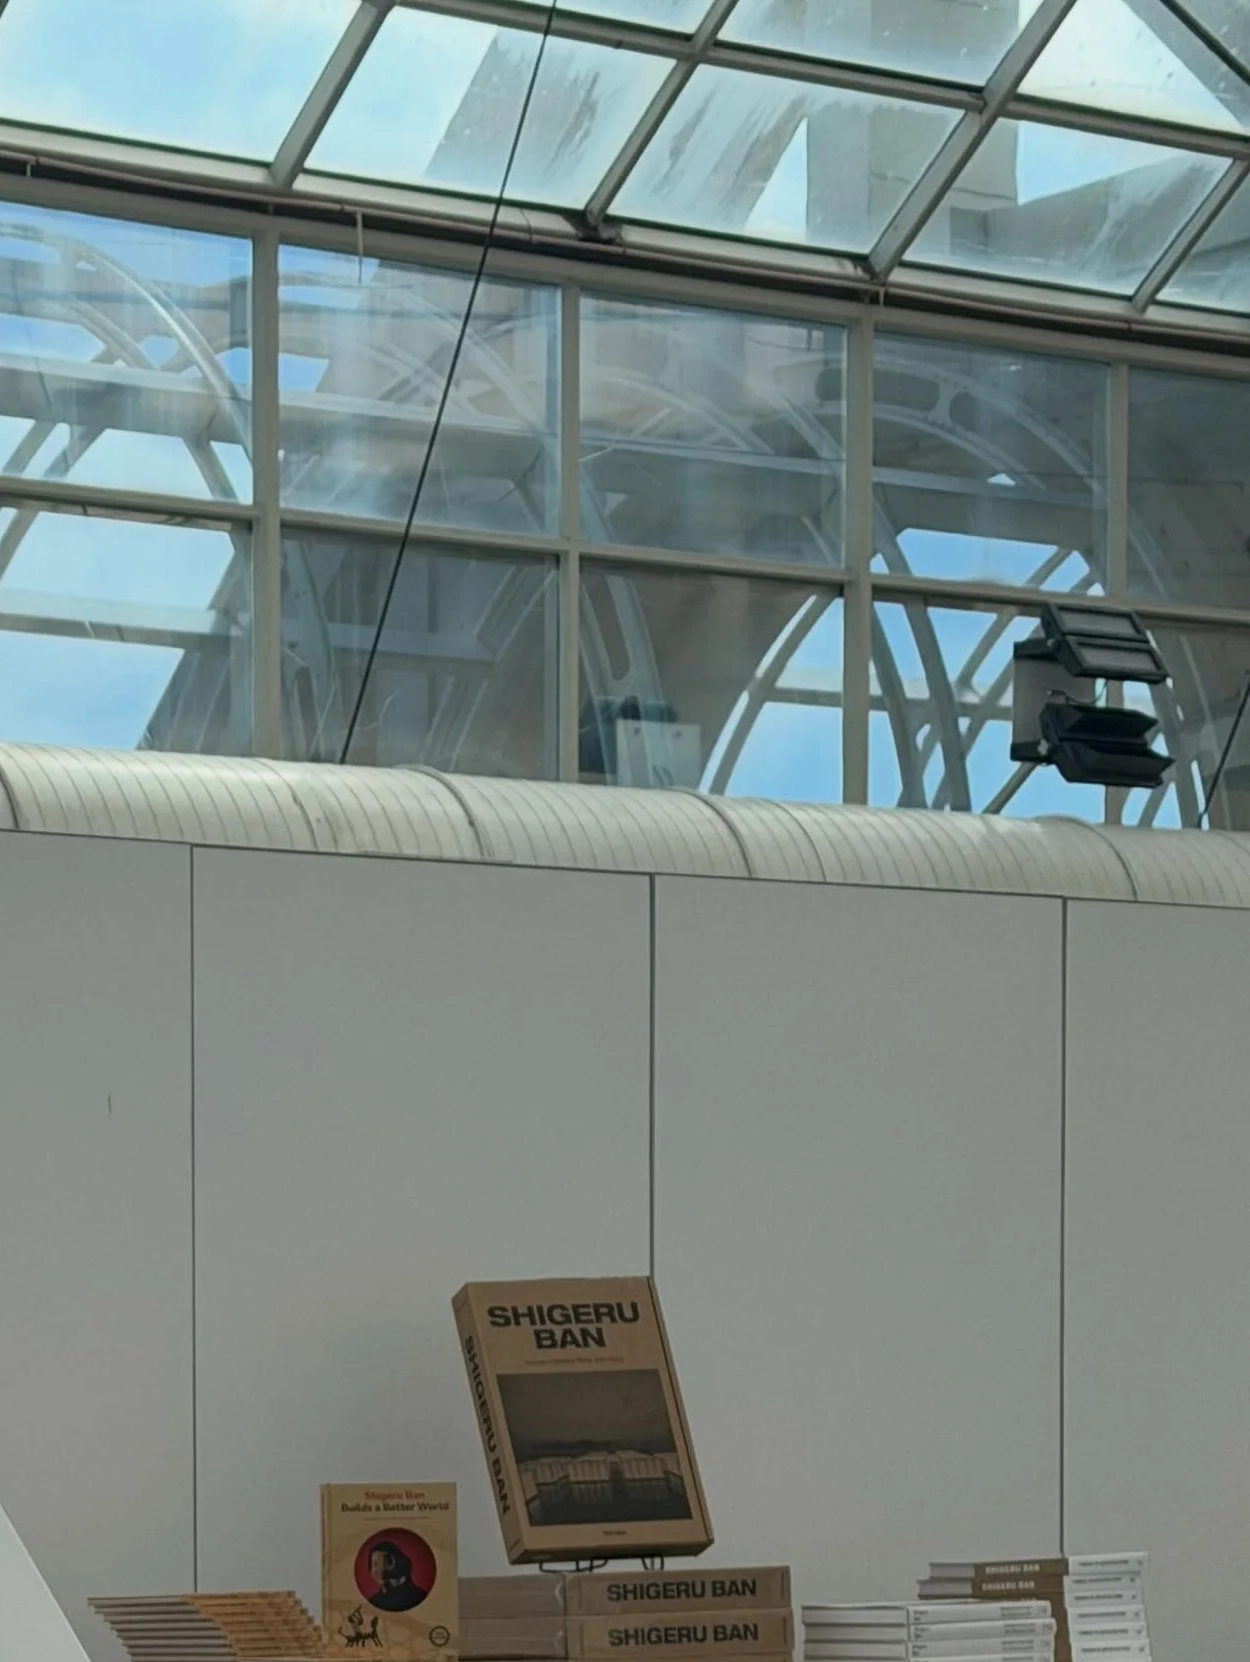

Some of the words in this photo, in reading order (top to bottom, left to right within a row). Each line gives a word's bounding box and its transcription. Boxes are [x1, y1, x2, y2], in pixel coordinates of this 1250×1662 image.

[487, 1302, 640, 1327] SHIGERU
[534, 1327, 606, 1349] BAN
[465, 1335, 497, 1453] SHIGERU
[492, 1457, 511, 1515] BAN
[341, 1503, 372, 1512] Builds
[383, 1502, 415, 1512] Better
[418, 1501, 450, 1511] World
[364, 1491, 404, 1503] Shigeru
[405, 1491, 425, 1500] Ban
[607, 1580, 705, 1602] SHIGERU
[712, 1580, 757, 1597] BAN
[608, 1625, 707, 1647] SHIGERU
[713, 1624, 758, 1642] BAN
